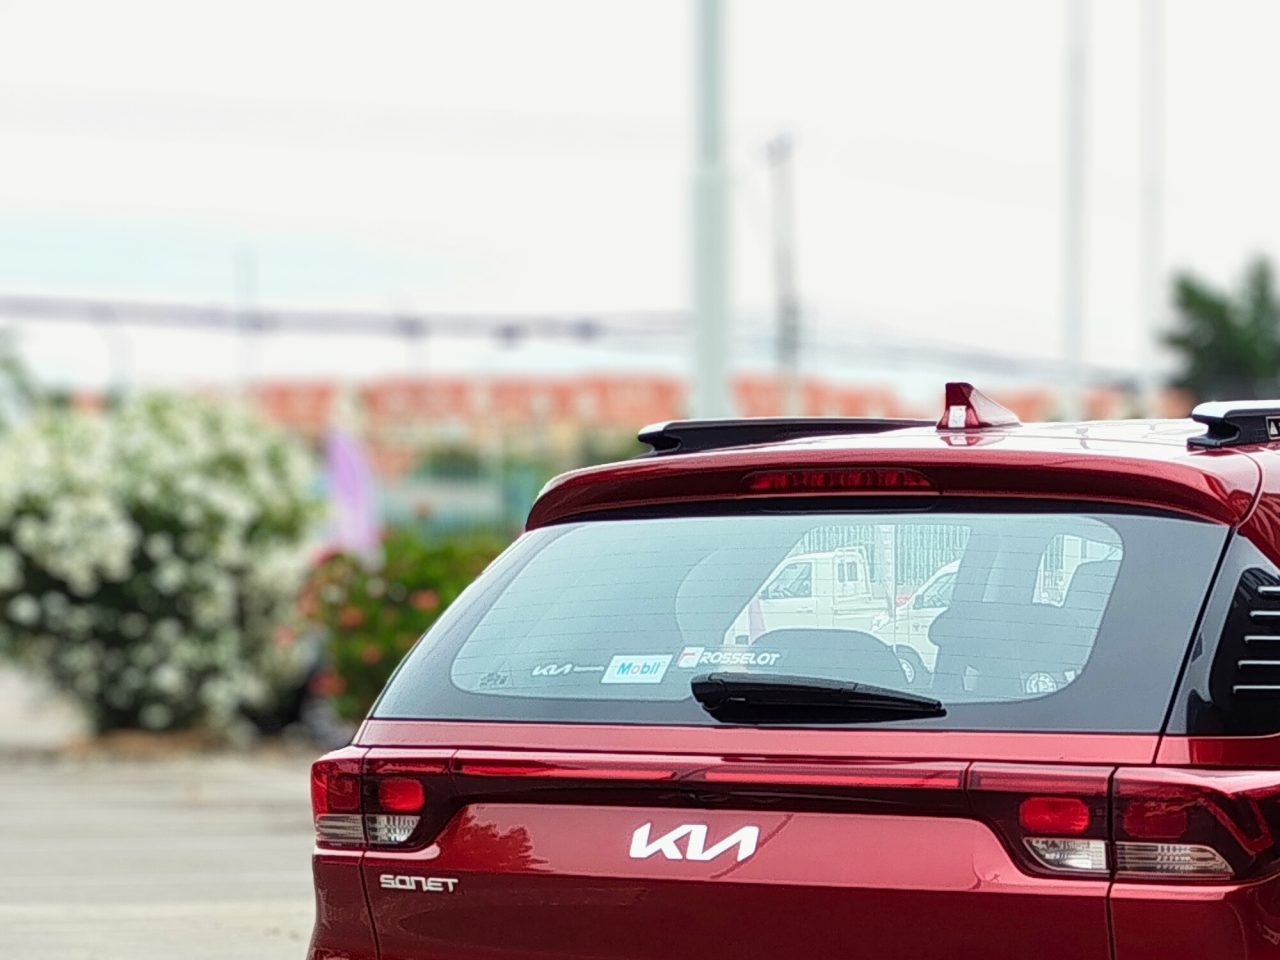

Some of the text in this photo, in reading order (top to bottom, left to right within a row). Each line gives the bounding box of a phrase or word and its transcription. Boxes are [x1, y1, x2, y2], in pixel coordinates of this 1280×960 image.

[700, 652, 780, 666] ROSSELOT
[616, 661, 662, 676] Mobil
[629, 822, 760, 862] KIA
[380, 874, 458, 892] SONET
